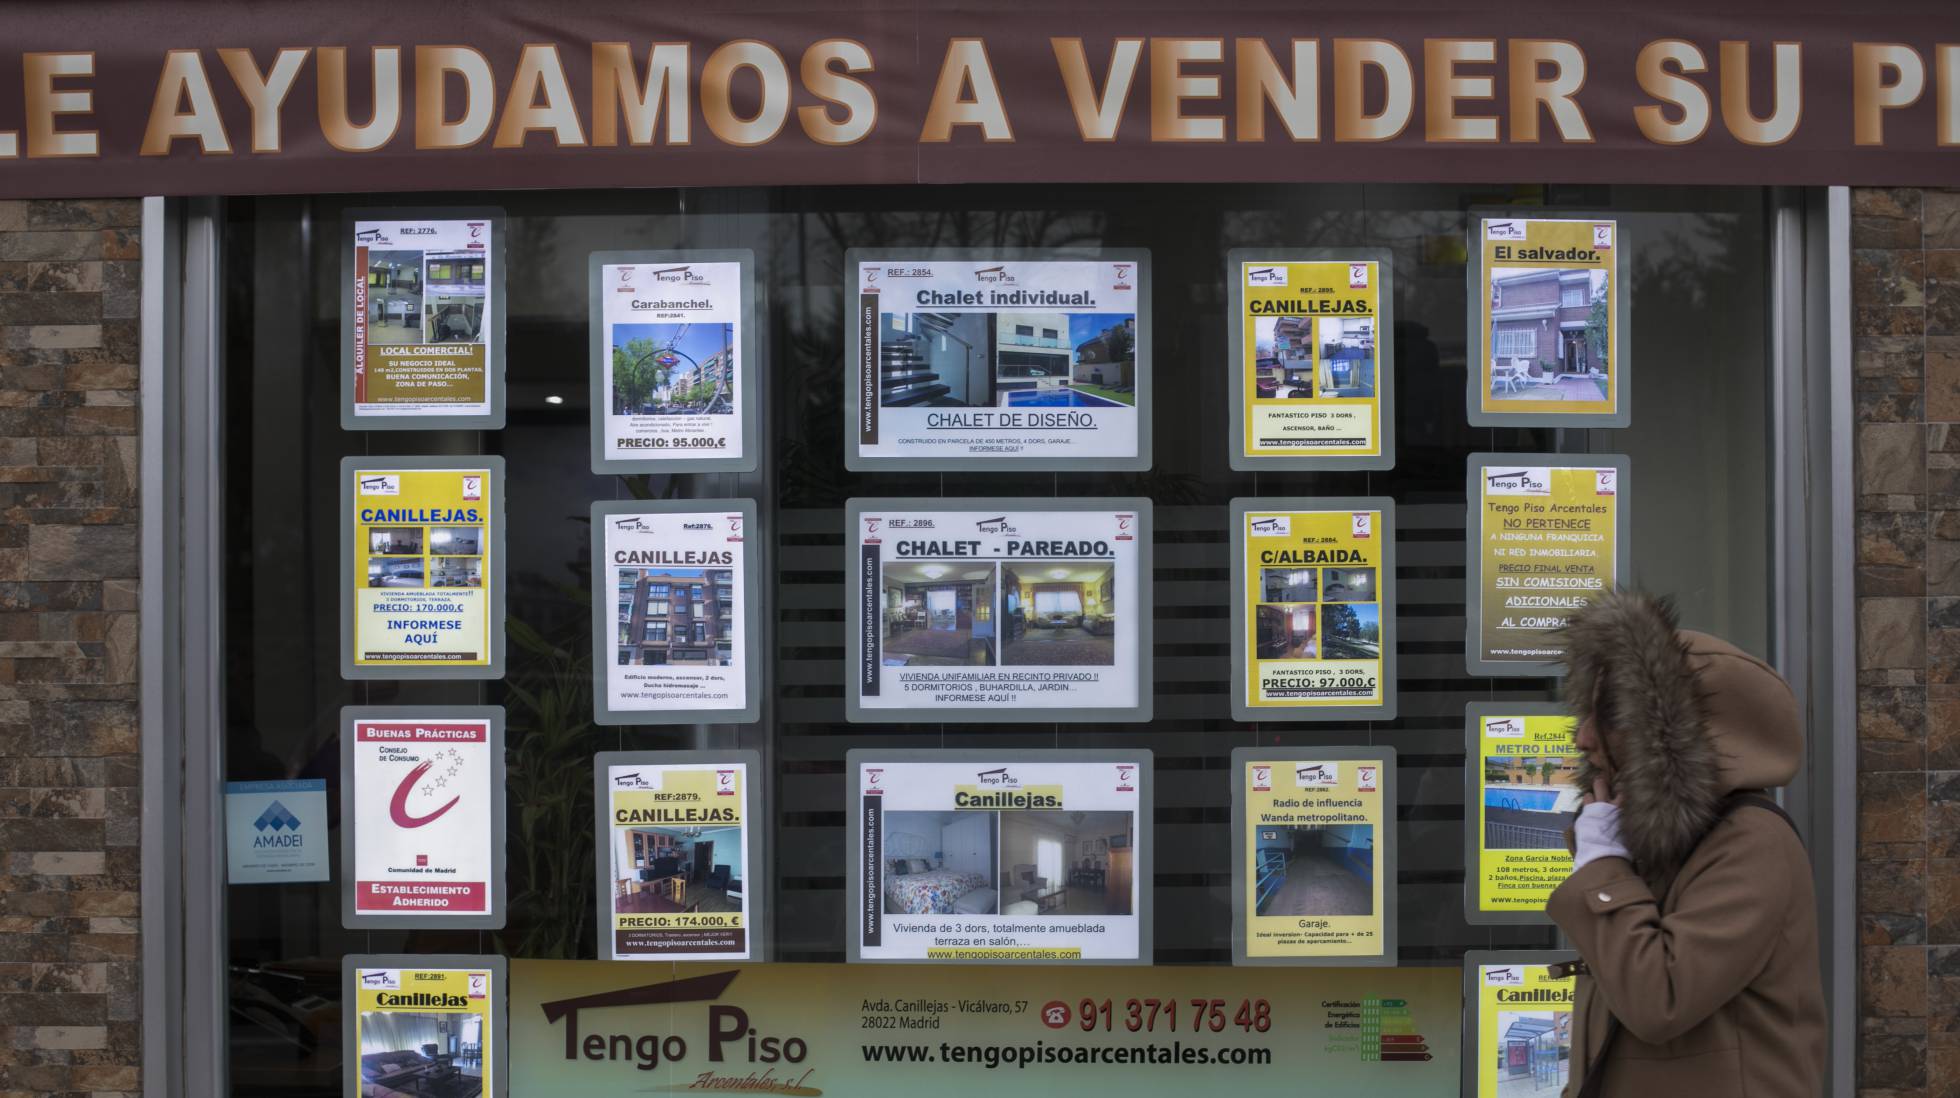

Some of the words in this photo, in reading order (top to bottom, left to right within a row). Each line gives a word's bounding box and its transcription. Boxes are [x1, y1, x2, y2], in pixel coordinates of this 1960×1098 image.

[0, 49, 100, 159] E
[139, 37, 878, 157] AYUDAMOS
[918, 38, 1015, 143] A
[1050, 37, 1595, 143] VENDER
[1633, 38, 1802, 144] SU
[1495, 246, 1511, 259] El
[1518, 246, 1600, 260] salvador.
[684, 271, 703, 281] Piso
[356, 276, 364, 304] LOCAL
[631, 300, 712, 308] Carabanchel.
[916, 290, 983, 305] Chalet
[990, 290, 1096, 305] individual.
[1250, 300, 1372, 313] CANILLEJAS.
[356, 307, 364, 324] DE
[356, 326, 364, 374] ALQUILER
[381, 347, 411, 355] LOCAL
[414, 347, 473, 355] COMERCIAL!
[864, 306, 873, 432] www.tengopisoarcentales.com
[927, 413, 995, 427] CHALET
[1000, 413, 1022, 427] DE
[1028, 411, 1097, 427] DISEÑO.
[617, 438, 669, 447] PRECIO:
[673, 438, 726, 447] 95.000,€
[1488, 475, 1517, 488] Tengo
[1521, 477, 1542, 488] Piso
[1488, 503, 1519, 514] Tengo
[1524, 503, 1544, 512] Piso
[1550, 504, 1607, 513] Arcentales
[361, 509, 483, 522] CANILLEJAS.
[976, 518, 998, 532] Tengo
[1001, 522, 1016, 532] Piso
[1504, 519, 1521, 528] NO
[1526, 519, 1591, 528] PERTENECE
[1546, 533, 1604, 542] FRANQUICIA
[896, 541, 981, 556] CHALET
[1007, 541, 1115, 556] PAREADO.
[615, 551, 733, 564] CANILLEJAS
[1261, 550, 1367, 563] C/ALBAIDA.
[1499, 564, 1531, 573] PRECIO
[1534, 564, 1561, 573] FINAL
[1565, 564, 1594, 573] VENTA
[1496, 577, 1519, 587] SIN
[1523, 577, 1602, 587] COMISIONES
[1506, 596, 1588, 607] ADICIONALES
[387, 620, 462, 629] INFORMESE
[866, 557, 874, 684] www.tengopisoarcentales.com
[1501, 617, 1516, 627] AL
[1520, 617, 1570, 627] COMPRA
[405, 631, 438, 645] AQUÍ
[900, 673, 940, 681] VIVIENDA
[942, 673, 996, 681] UNIFAMILIAR
[998, 673, 1010, 681] EN
[1013, 673, 1050, 681] RECINTO
[1053, 673, 1092, 681] PRIVADO
[1263, 678, 1315, 688] PRECIO:
[1320, 678, 1375, 688] 97.000,€
[980, 684, 1036, 692] BUHARDILLA,
[988, 694, 1009, 703] AQUÍ
[367, 728, 411, 738] BUENAS
[416, 728, 477, 738] PRÁCTICAS
[1496, 744, 1540, 753] METRO
[1544, 744, 1577, 753] LINE
[978, 770, 999, 784] Tengo
[1002, 773, 1018, 783] Piso
[955, 791, 1062, 809] Canillejas.
[1273, 799, 1300, 807] Radio
[1302, 799, 1314, 807] de
[1317, 799, 1362, 807] influencia
[616, 808, 740, 822] CANILLEJAS.
[1261, 814, 1294, 822] Wanda
[1297, 813, 1367, 823] metropolitano.
[253, 834, 303, 848] AMADEI
[868, 808, 876, 934] www.tengopisoarcentales.com
[371, 884, 470, 894] ESTABLECIMIENTO
[393, 896, 449, 907] ADHERIDO
[619, 917, 671, 926] PRECIO:
[675, 917, 727, 926] 174.000,
[731, 917, 739, 926] €
[893, 923, 936, 932] Vivienda
[940, 923, 952, 932] de
[956, 924, 961, 932] 3
[965, 923, 990, 934] dors,
[993, 924, 1046, 932] totalmente
[1049, 923, 1105, 932] amueblada
[626, 939, 735, 948] www.tengopisoarcentales.com
[928, 950, 1081, 959] www.tengopisoarcentales.com
[376, 993, 468, 1006] Canillejas
[1497, 989, 1575, 1002] Canilleja
[861, 1000, 892, 1012] Avda.
[895, 1000, 949, 1015] Canillejas
[959, 1000, 1012, 1014] Vicálvaro,
[1015, 1001, 1028, 1013] 57
[1079, 998, 1113, 1032] 91
[1125, 998, 1176, 1032] 371
[1191, 998, 1226, 1032] 75
[1234, 998, 1271, 1033] 48
[861, 1016, 896, 1029] 28022
[899, 1016, 940, 1029] Madrid
[543, 1000, 687, 1070] Tengo
[708, 1004, 808, 1063] Piso
[688, 1068, 778, 1092] Arcentales,
